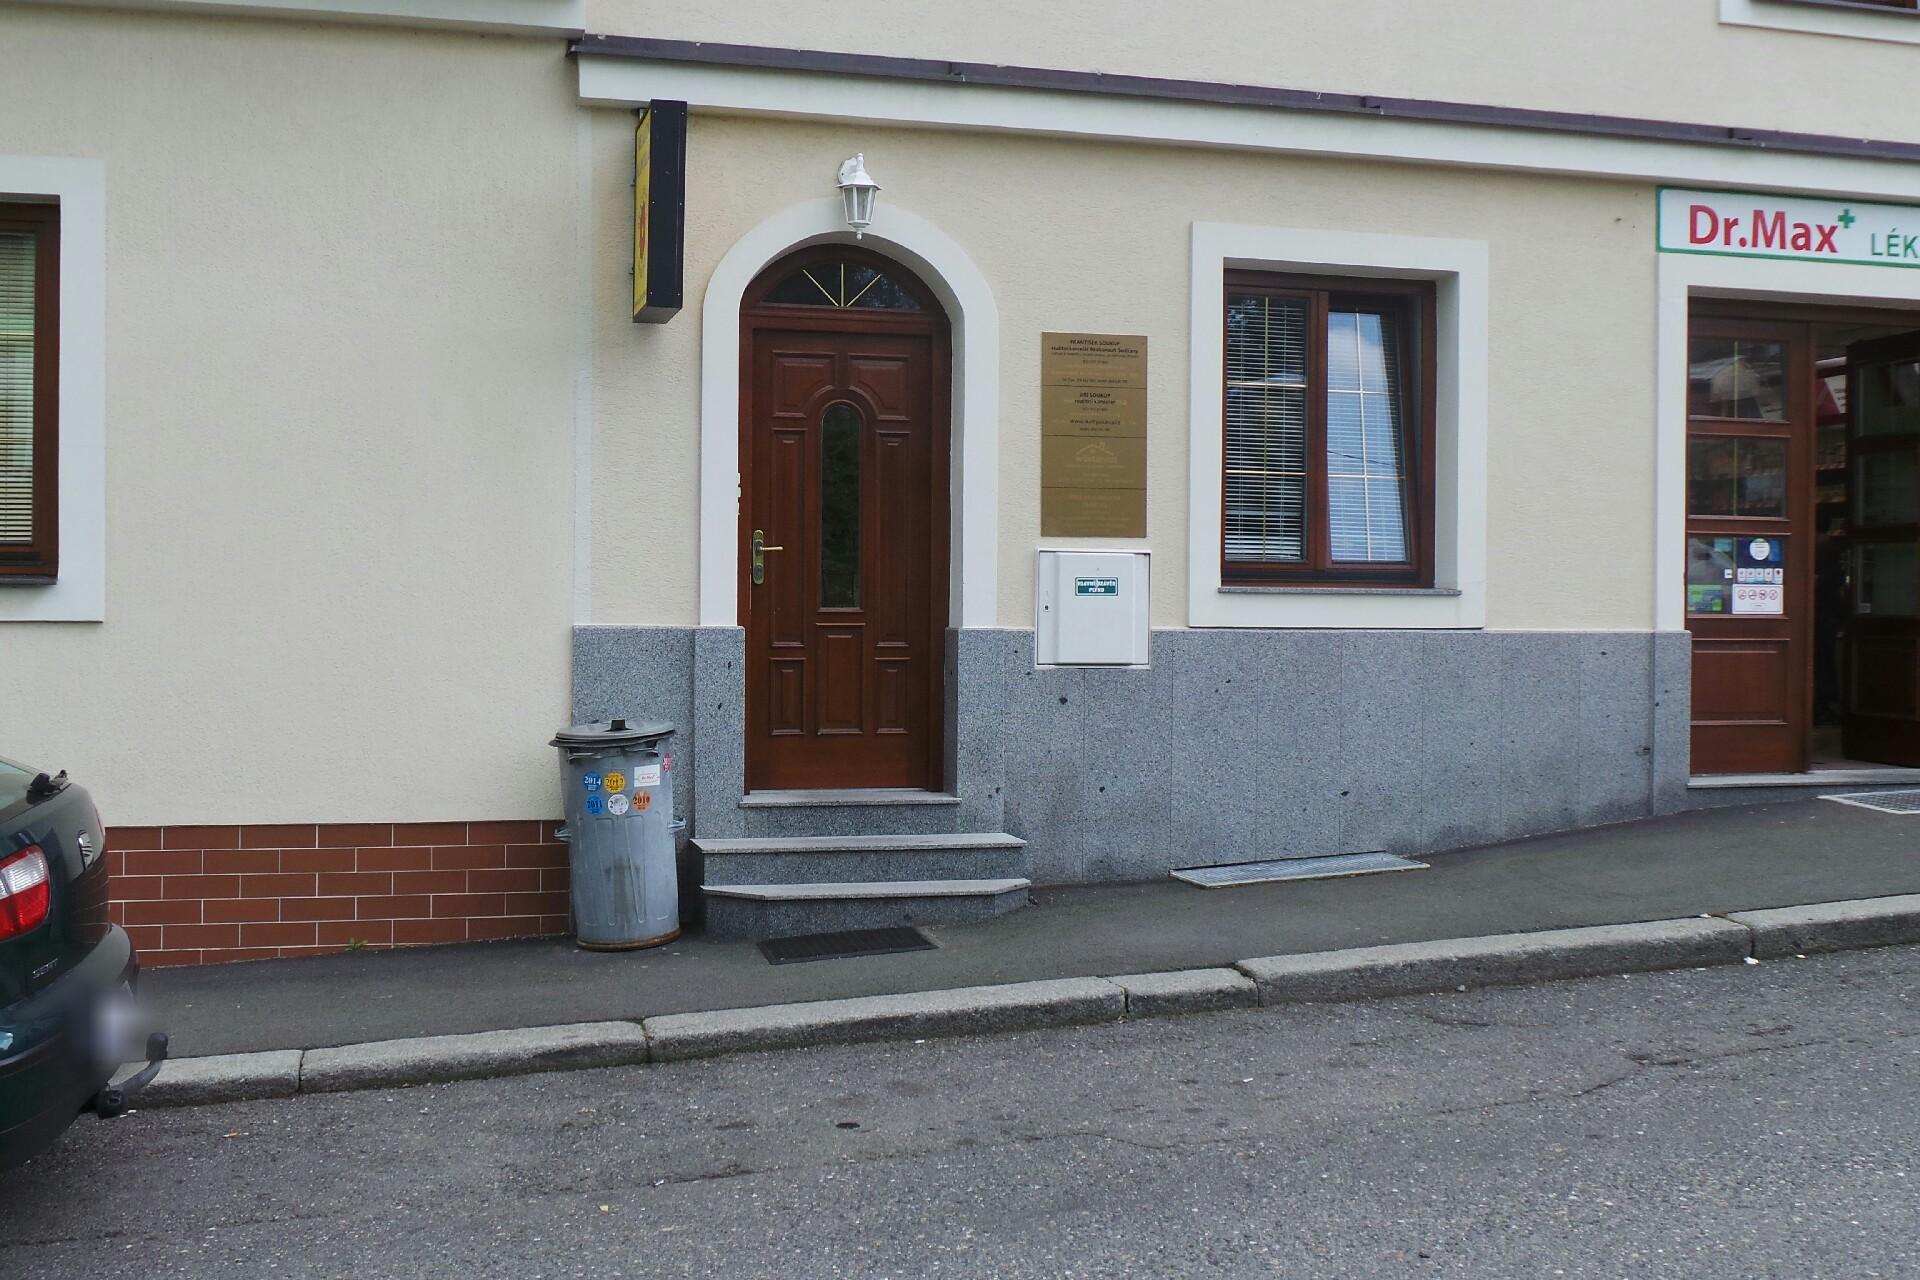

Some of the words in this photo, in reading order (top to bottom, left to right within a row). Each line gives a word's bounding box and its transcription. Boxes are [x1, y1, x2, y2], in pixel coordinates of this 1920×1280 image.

[1689, 204, 1839, 254] Dr.Max
[1871, 228, 1920, 259] LÉK
[584, 776, 601, 786] 2014
